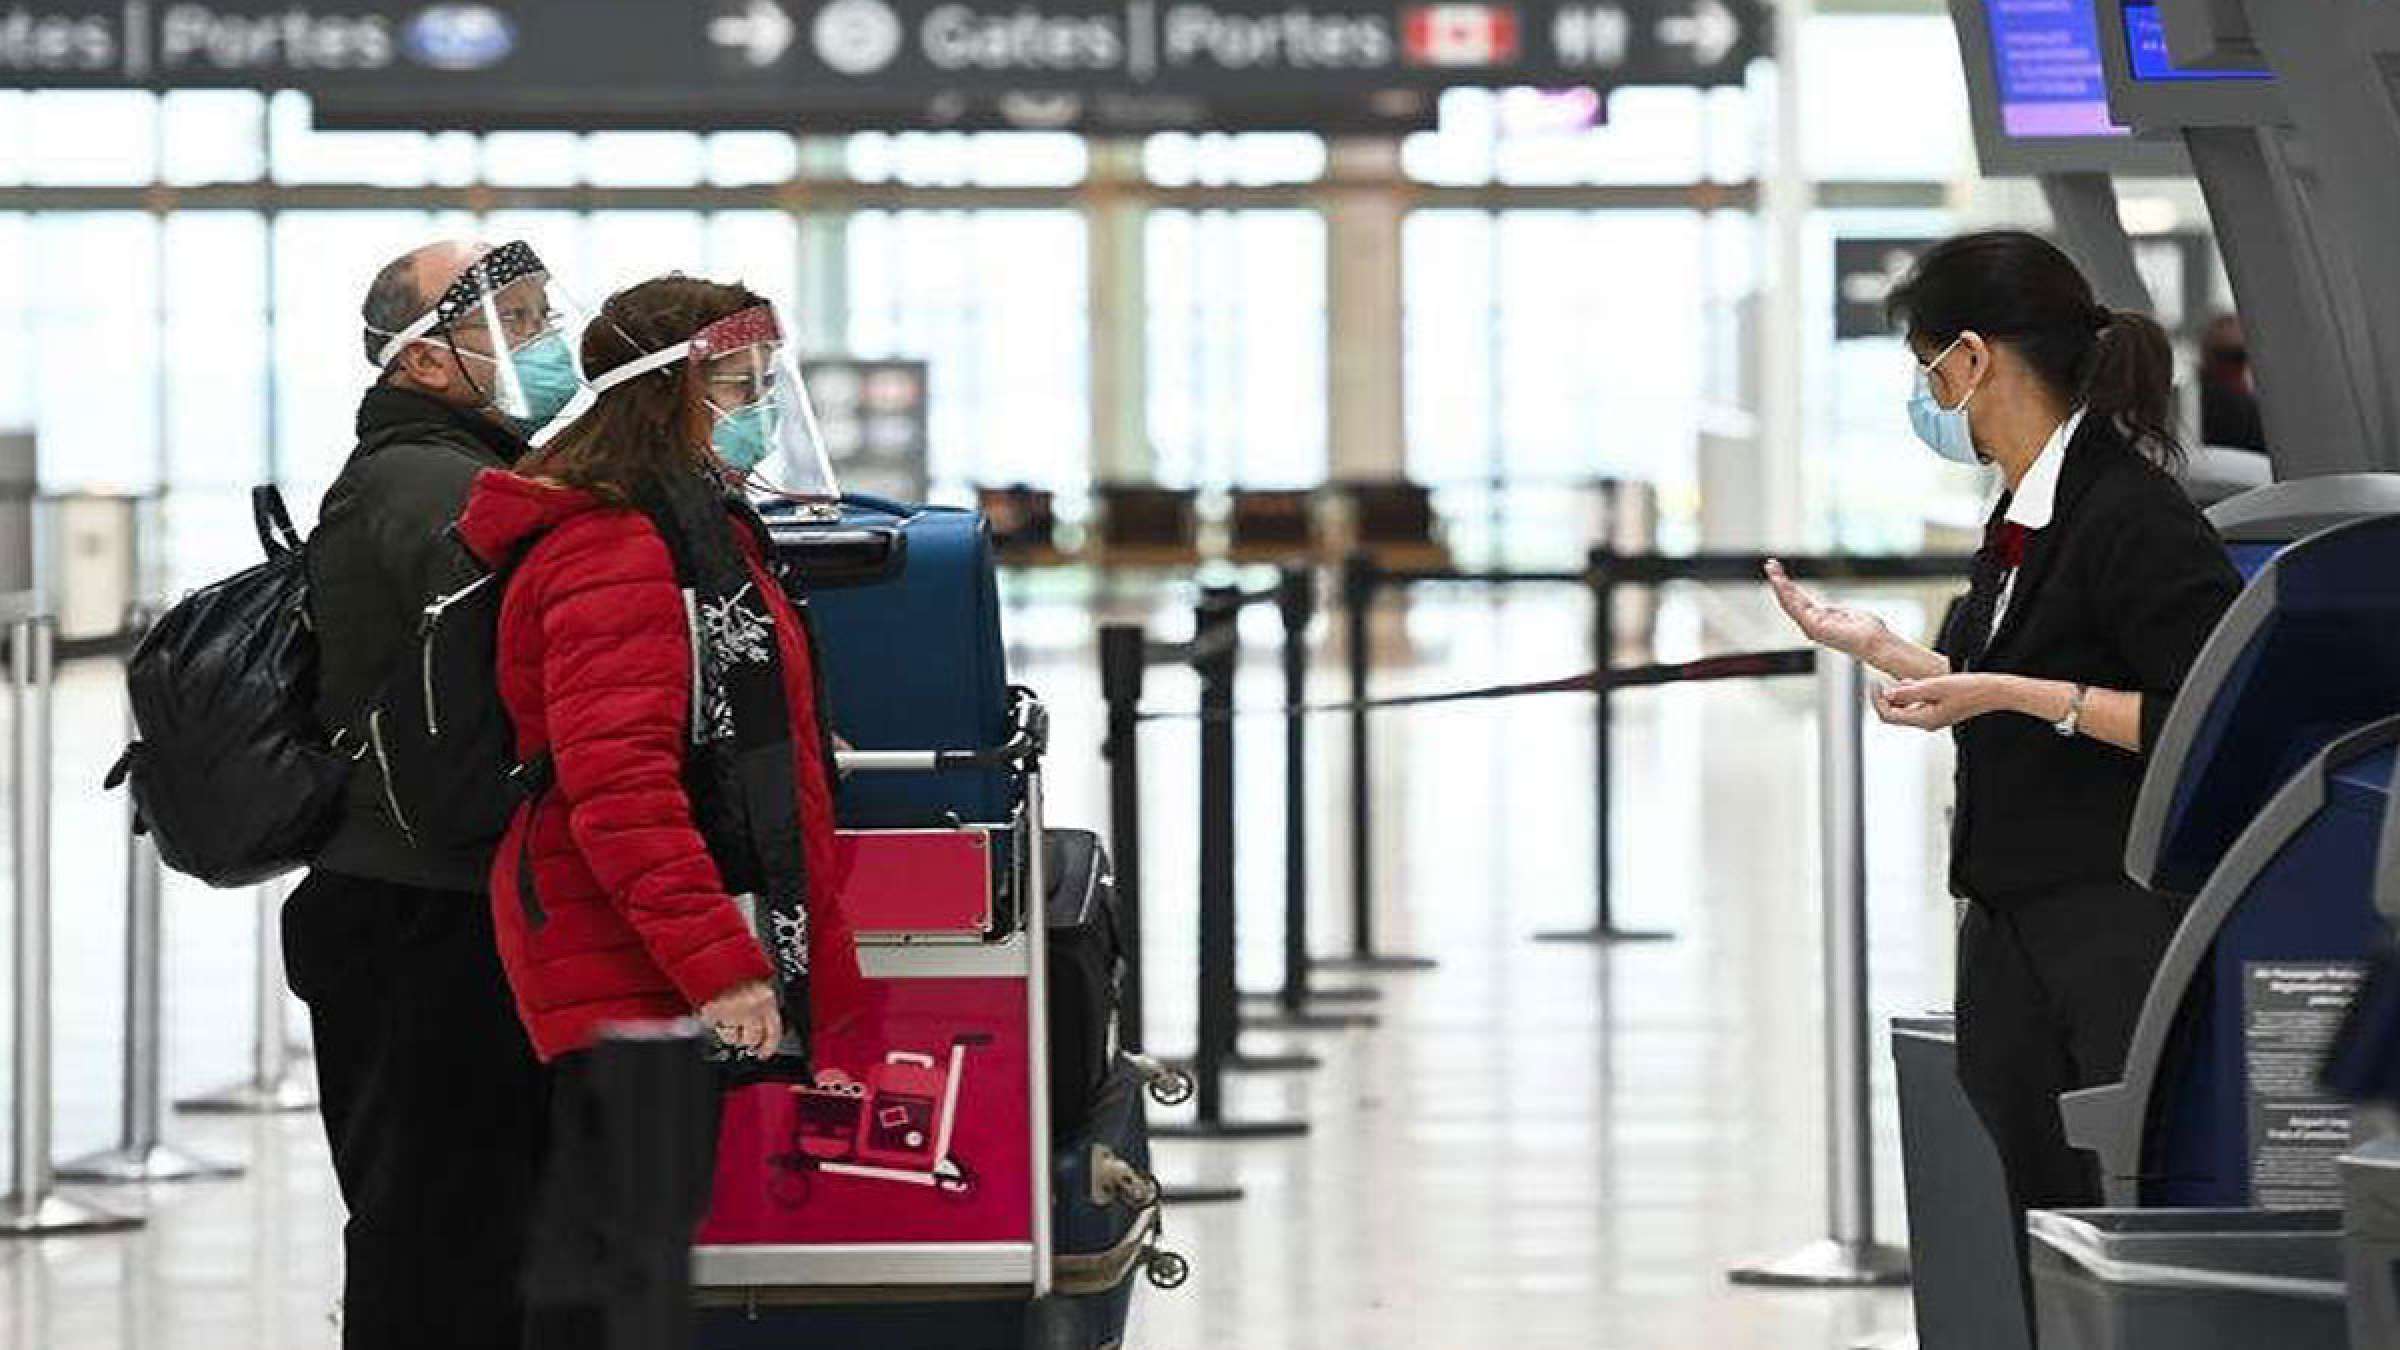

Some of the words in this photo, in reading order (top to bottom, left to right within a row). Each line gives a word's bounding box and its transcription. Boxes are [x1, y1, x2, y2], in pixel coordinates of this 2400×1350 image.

[162, 4, 392, 68] Portes
[921, 4, 1121, 70] Gates
[1166, 4, 1393, 70] Portes
